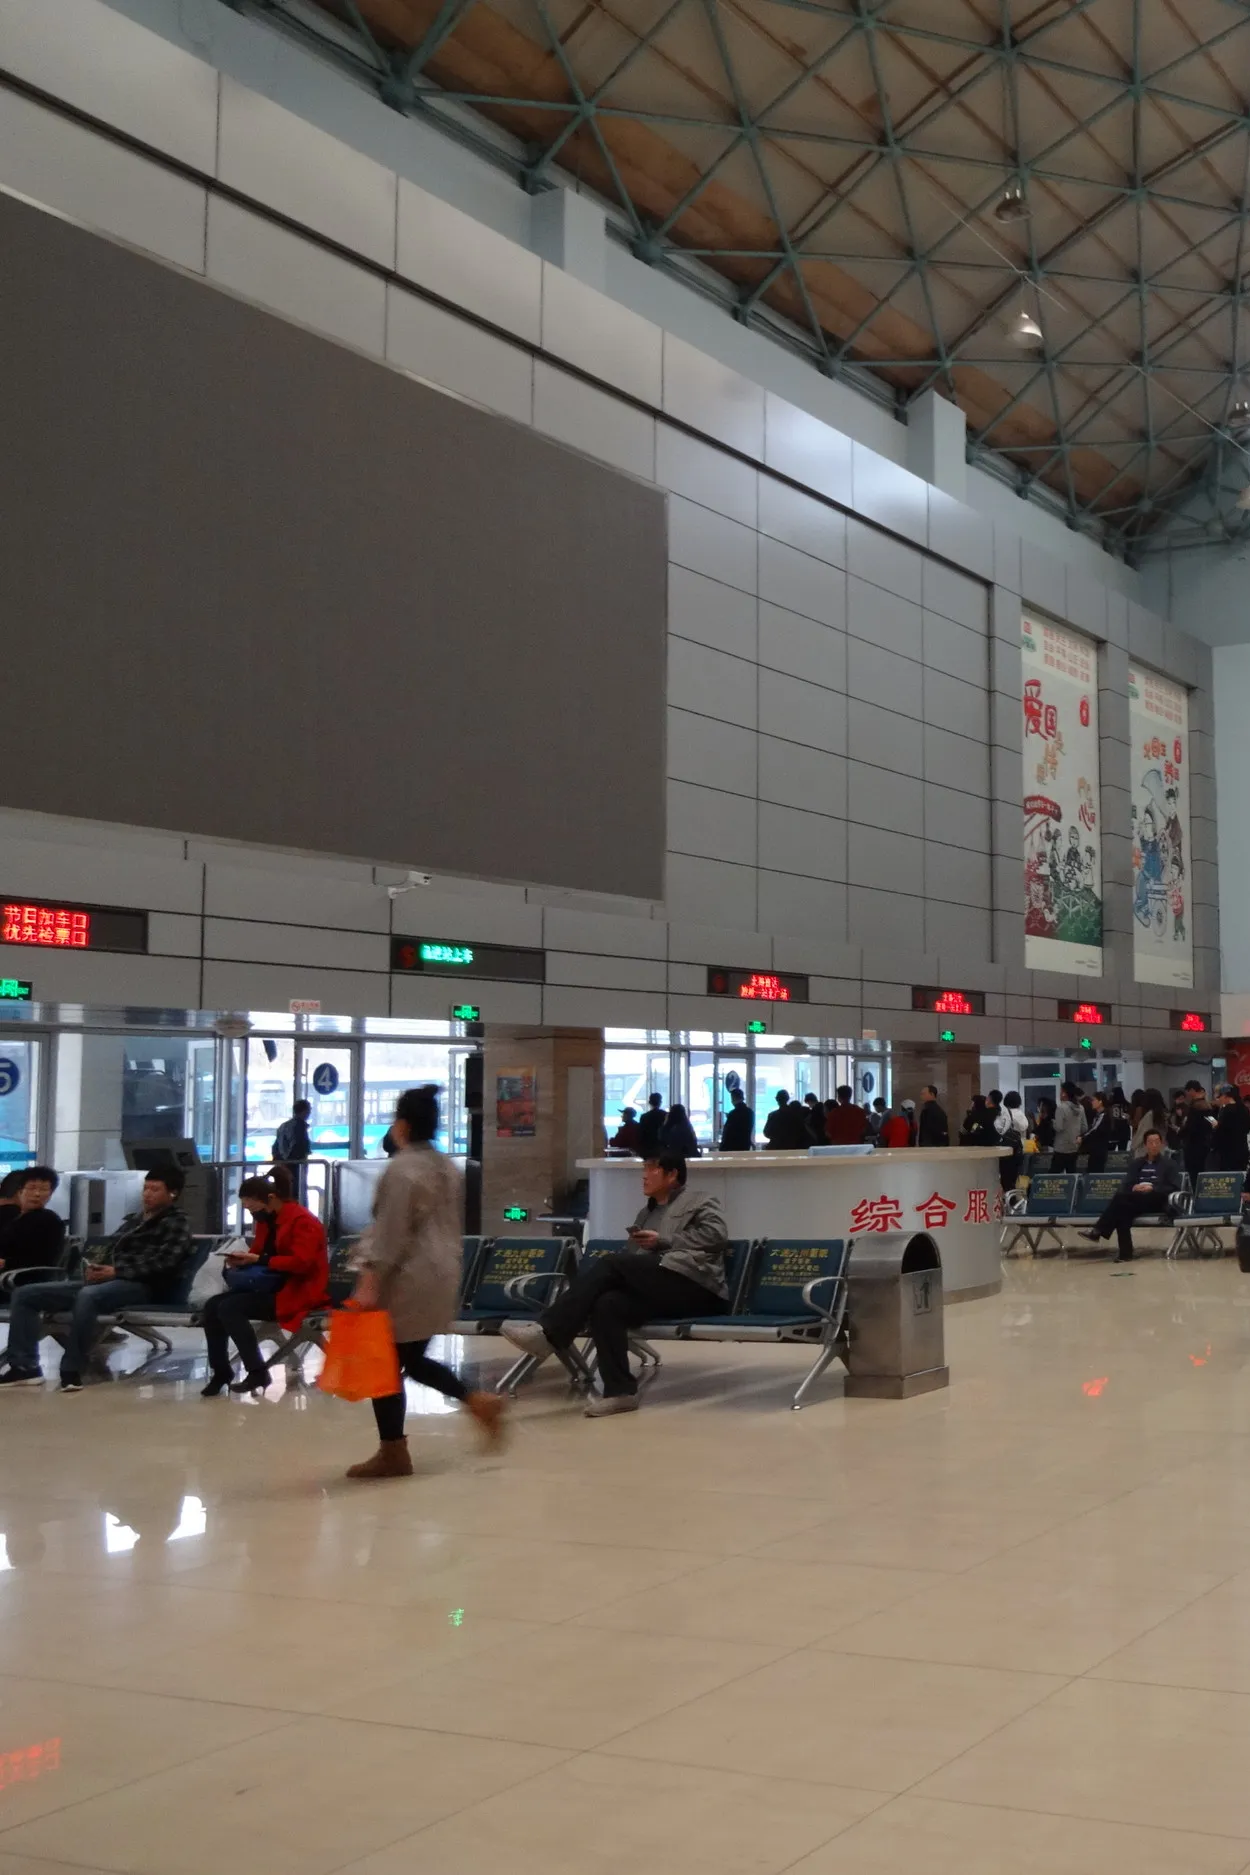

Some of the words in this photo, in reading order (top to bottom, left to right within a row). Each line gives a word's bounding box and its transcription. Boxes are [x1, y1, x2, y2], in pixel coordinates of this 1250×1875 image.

[4, 906, 88, 929] 节日加车口
[4, 924, 87, 946] 优先检票口
[318, 1066, 333, 1092] 4
